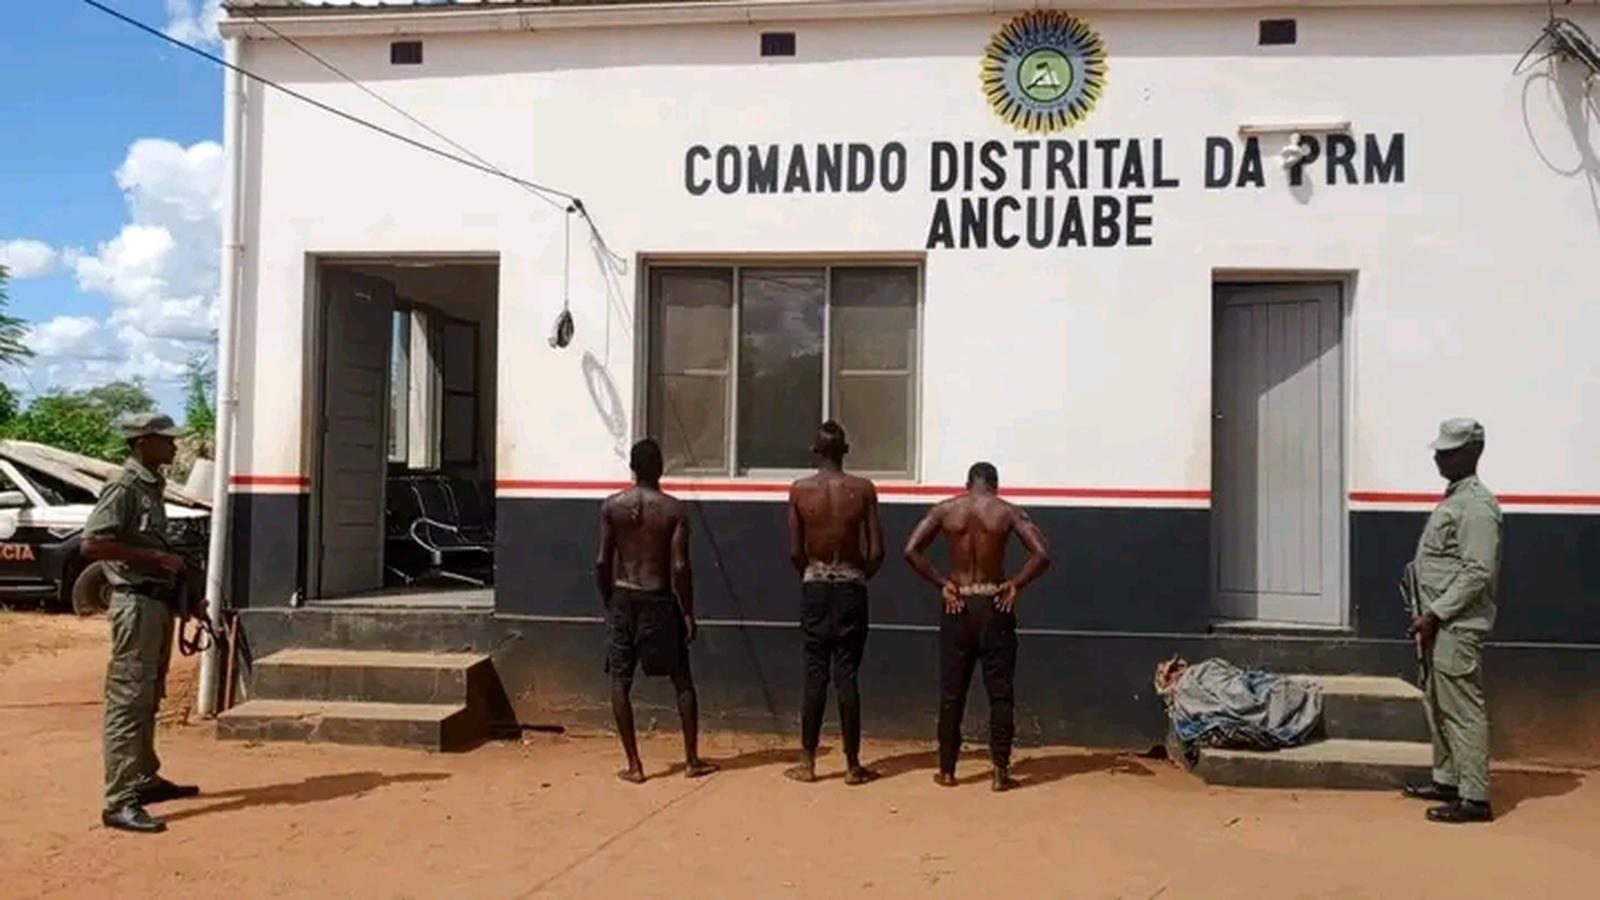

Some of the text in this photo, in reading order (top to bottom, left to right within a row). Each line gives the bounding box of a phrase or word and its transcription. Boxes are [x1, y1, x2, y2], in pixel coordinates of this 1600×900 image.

[684, 133, 1405, 196] COMANDO DISTRITAL DA PRM
[925, 195, 1153, 249] ANCUABE
[0, 542, 36, 561] CIA
